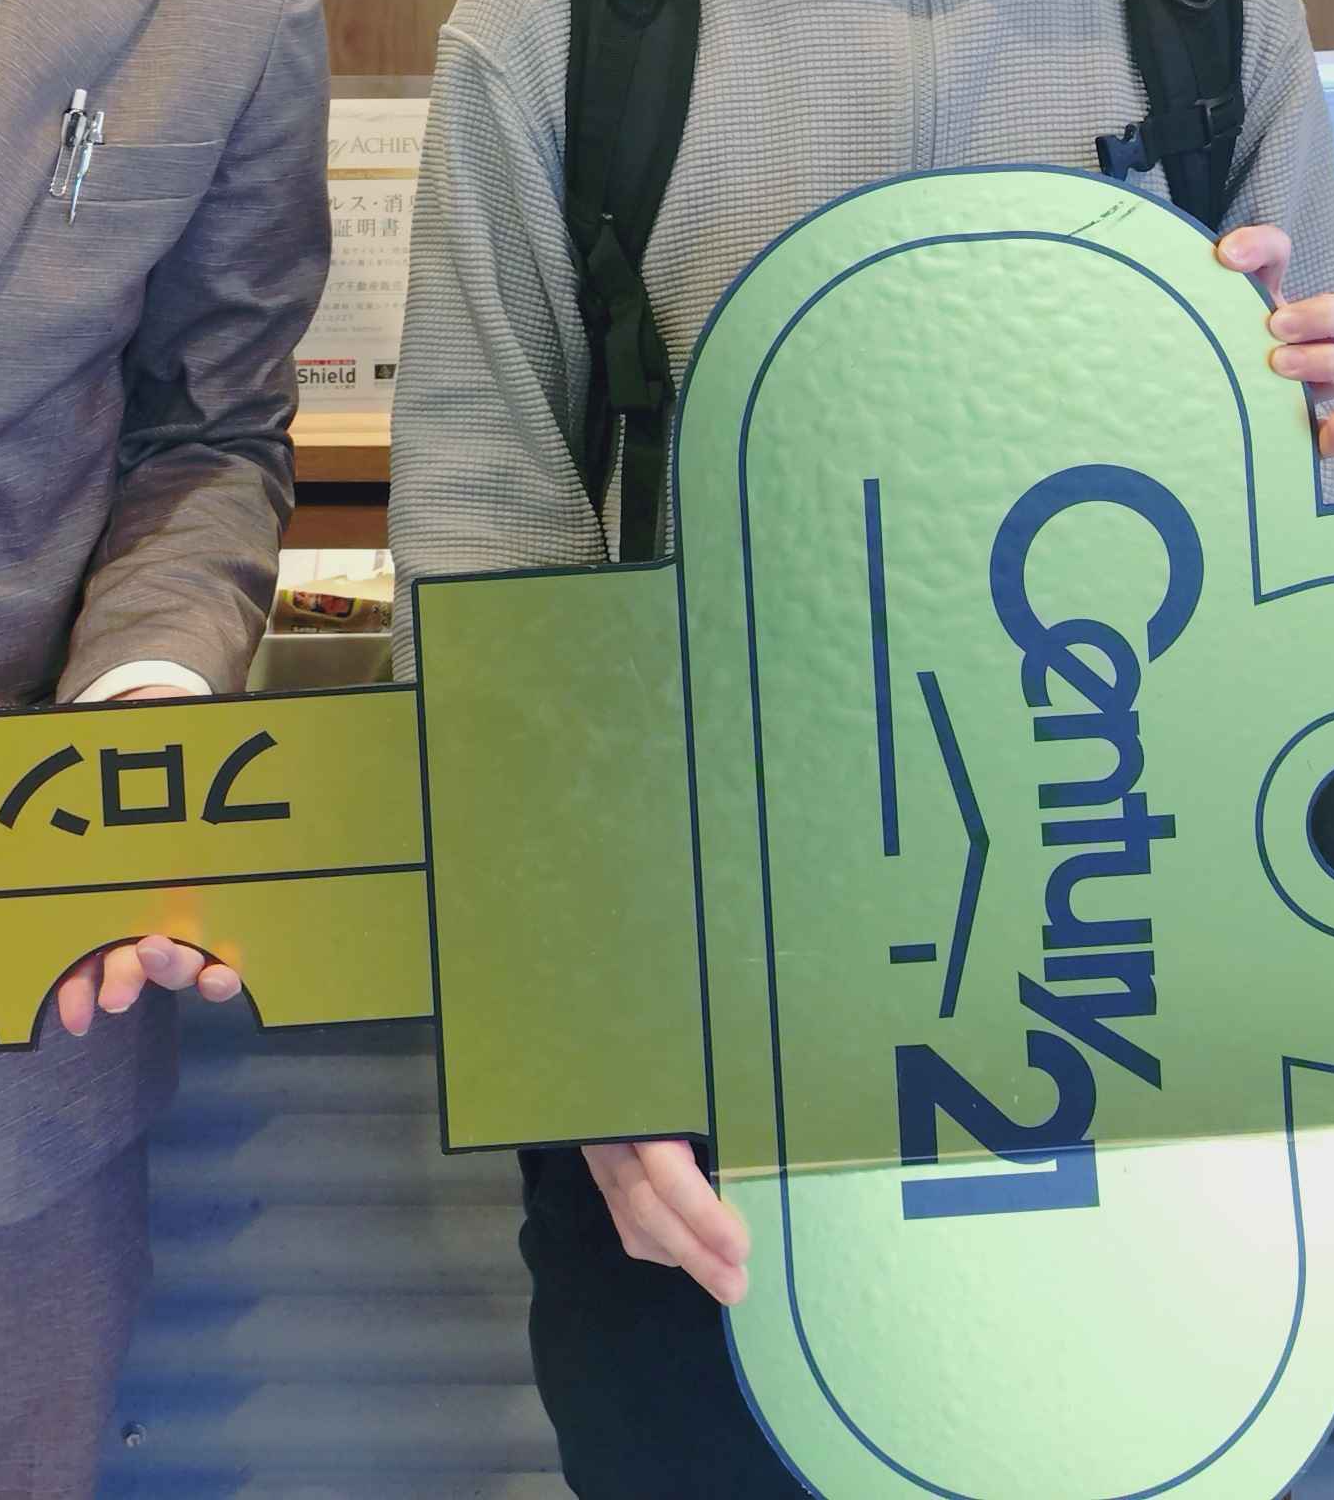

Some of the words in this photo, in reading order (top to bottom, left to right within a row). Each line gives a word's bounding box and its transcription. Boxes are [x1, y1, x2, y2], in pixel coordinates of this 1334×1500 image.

[333, 218, 401, 238] 証明書
[297, 368, 356, 385] Shield
[989, 463, 1204, 1090] Century
[895, 1029, 1100, 1220] 21
